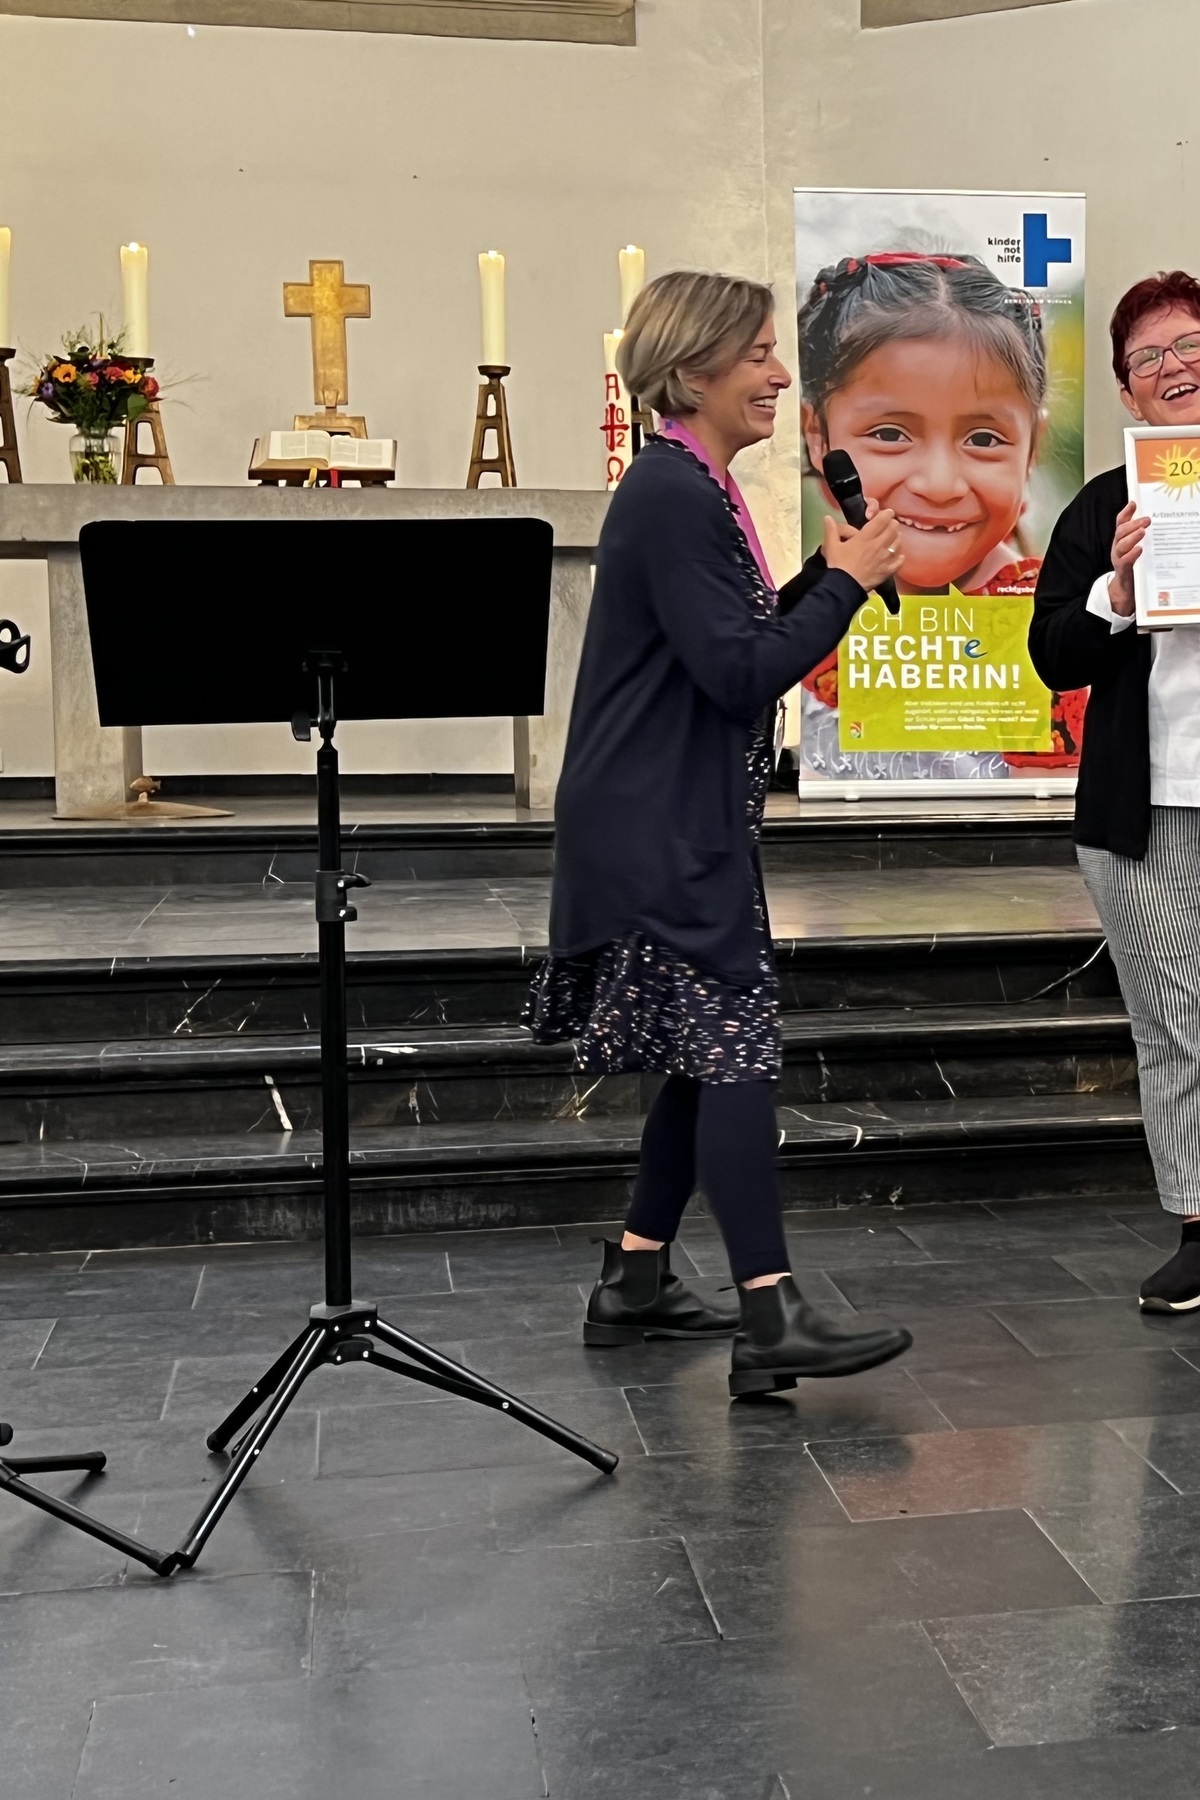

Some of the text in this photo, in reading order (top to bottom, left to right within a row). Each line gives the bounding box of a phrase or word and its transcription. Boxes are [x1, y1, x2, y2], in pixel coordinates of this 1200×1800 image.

[987, 237, 1021, 246] kinder
[1004, 246, 1021, 254] not
[997, 254, 1021, 263] hilfe
[849, 606, 974, 633] CH BIN
[848, 663, 1021, 689] HABERIN!
